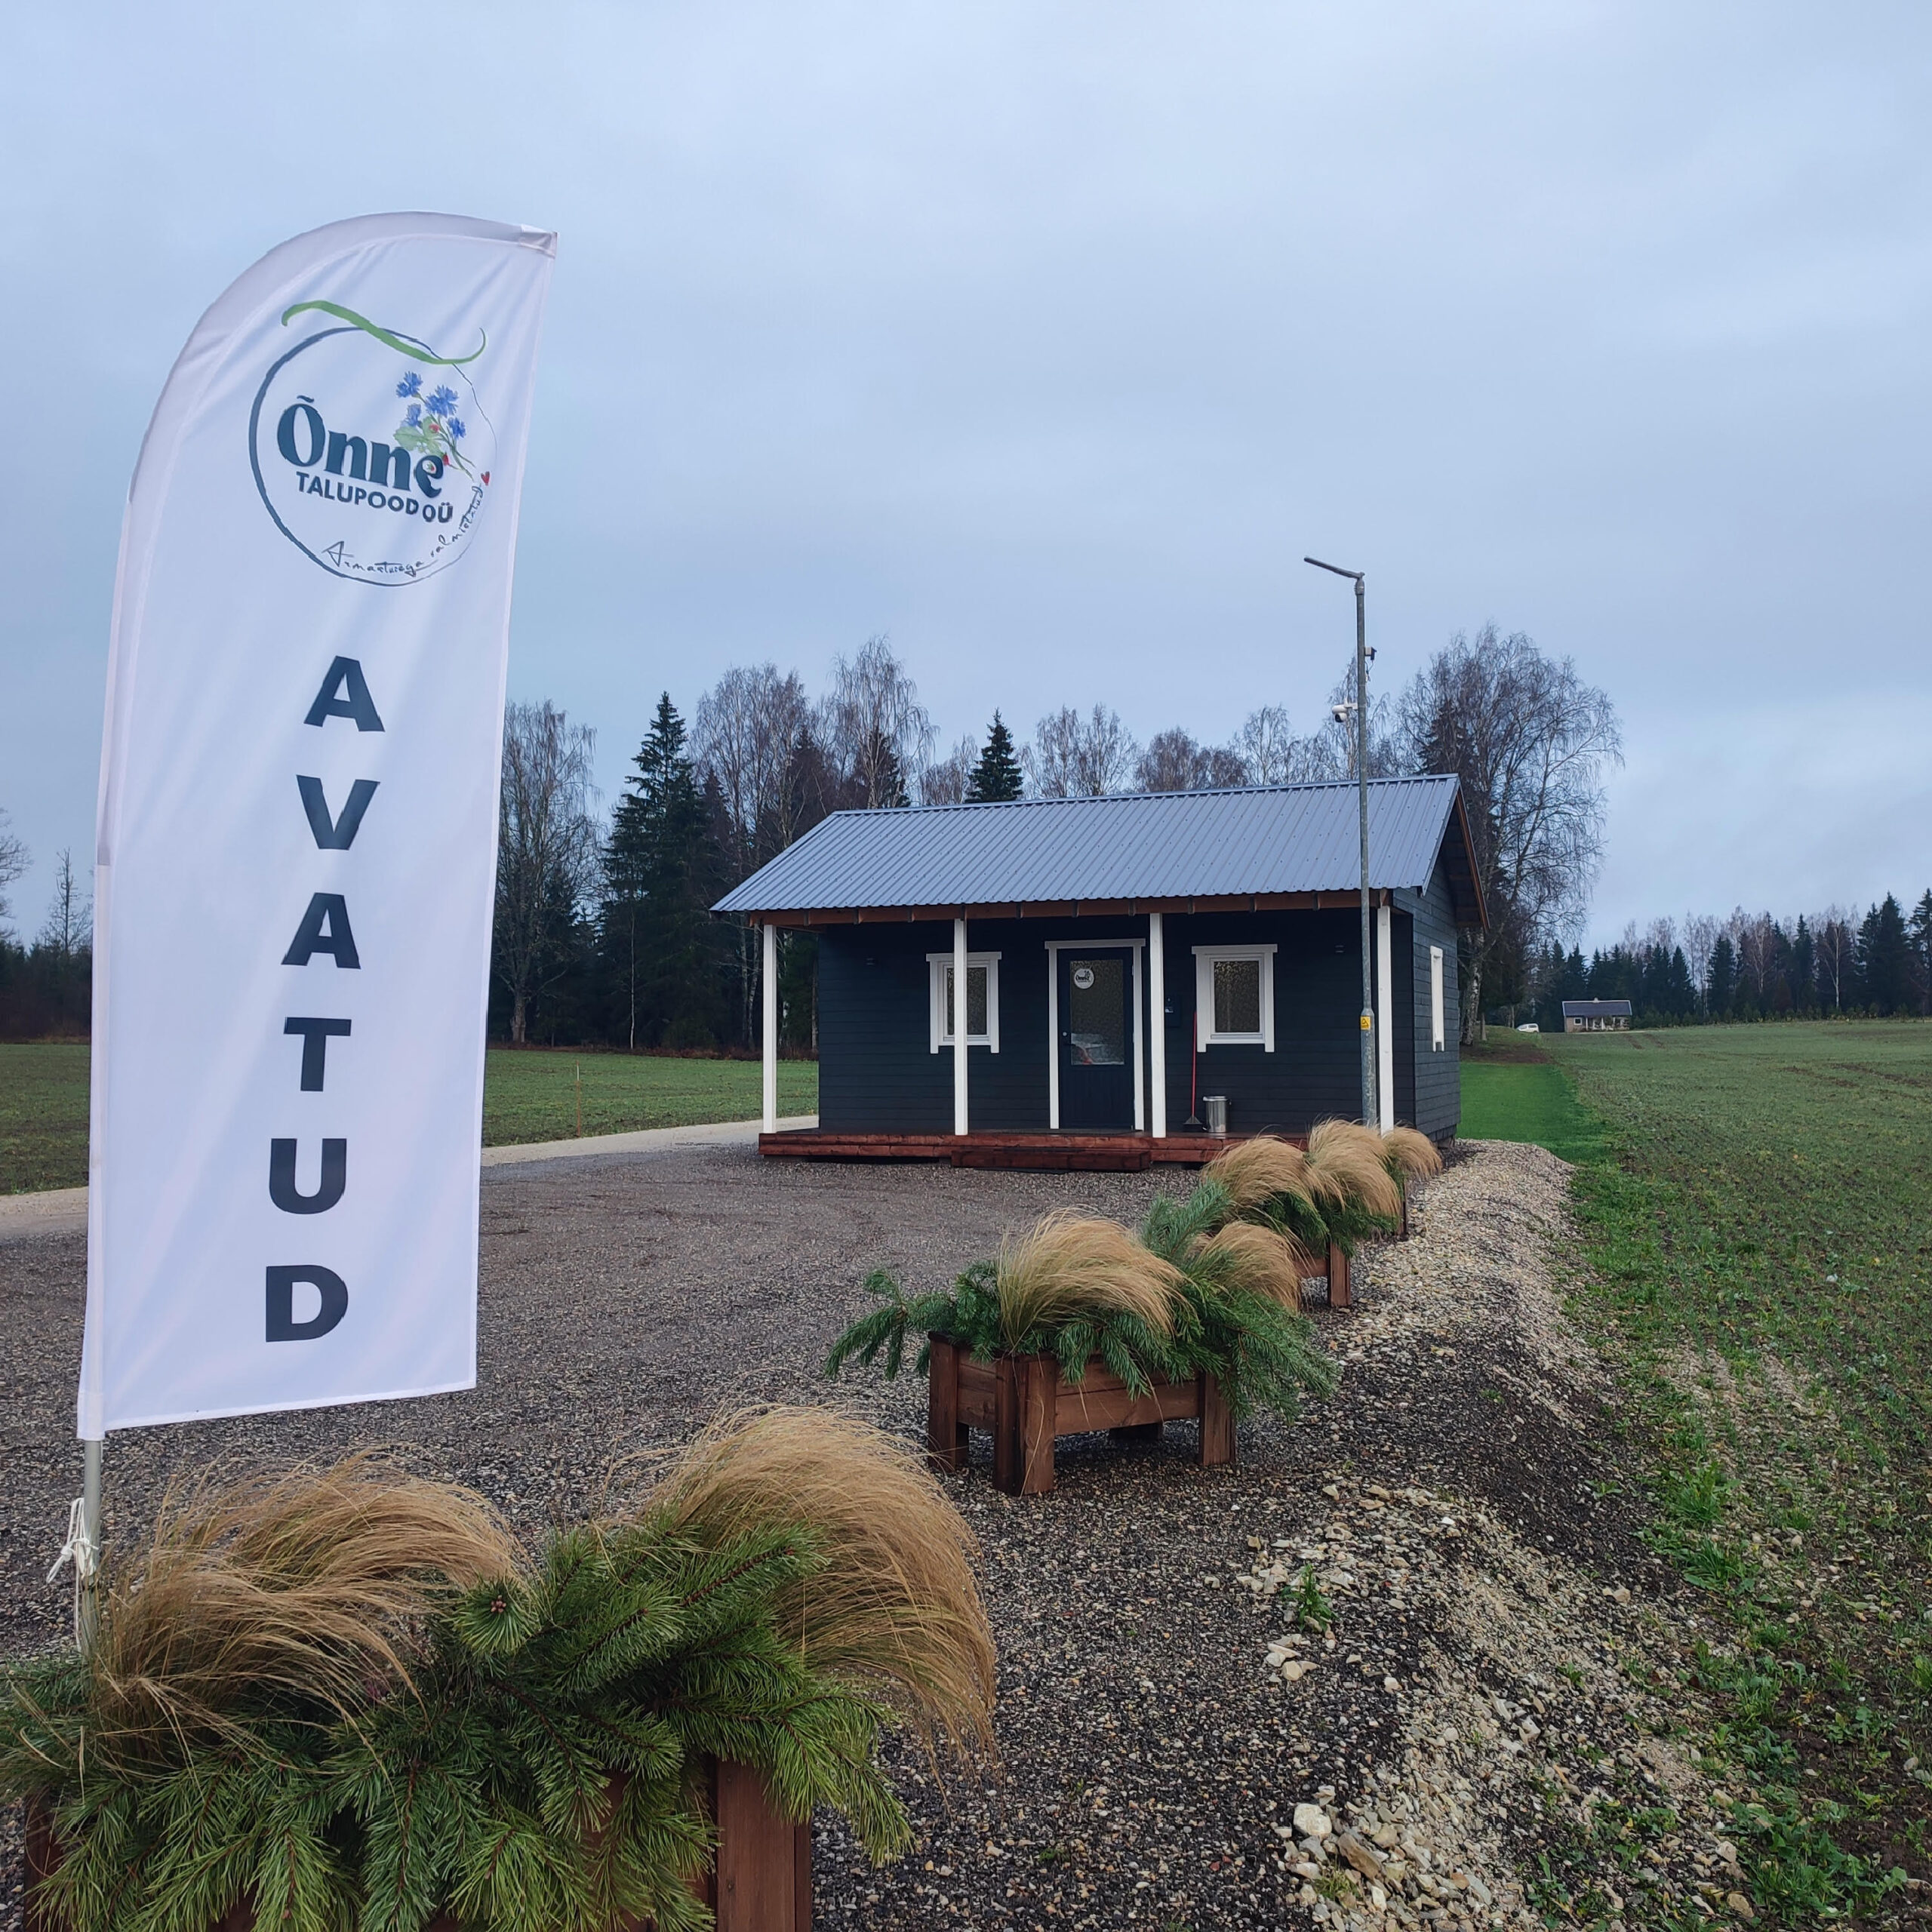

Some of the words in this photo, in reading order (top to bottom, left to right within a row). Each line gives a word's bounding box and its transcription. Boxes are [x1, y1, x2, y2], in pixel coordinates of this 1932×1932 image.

[276, 395, 444, 498] Õnne
[296, 471, 419, 515] TALUPOOD
[422, 501, 453, 523] OÜ
[266, 655, 386, 1343] AVATUD
